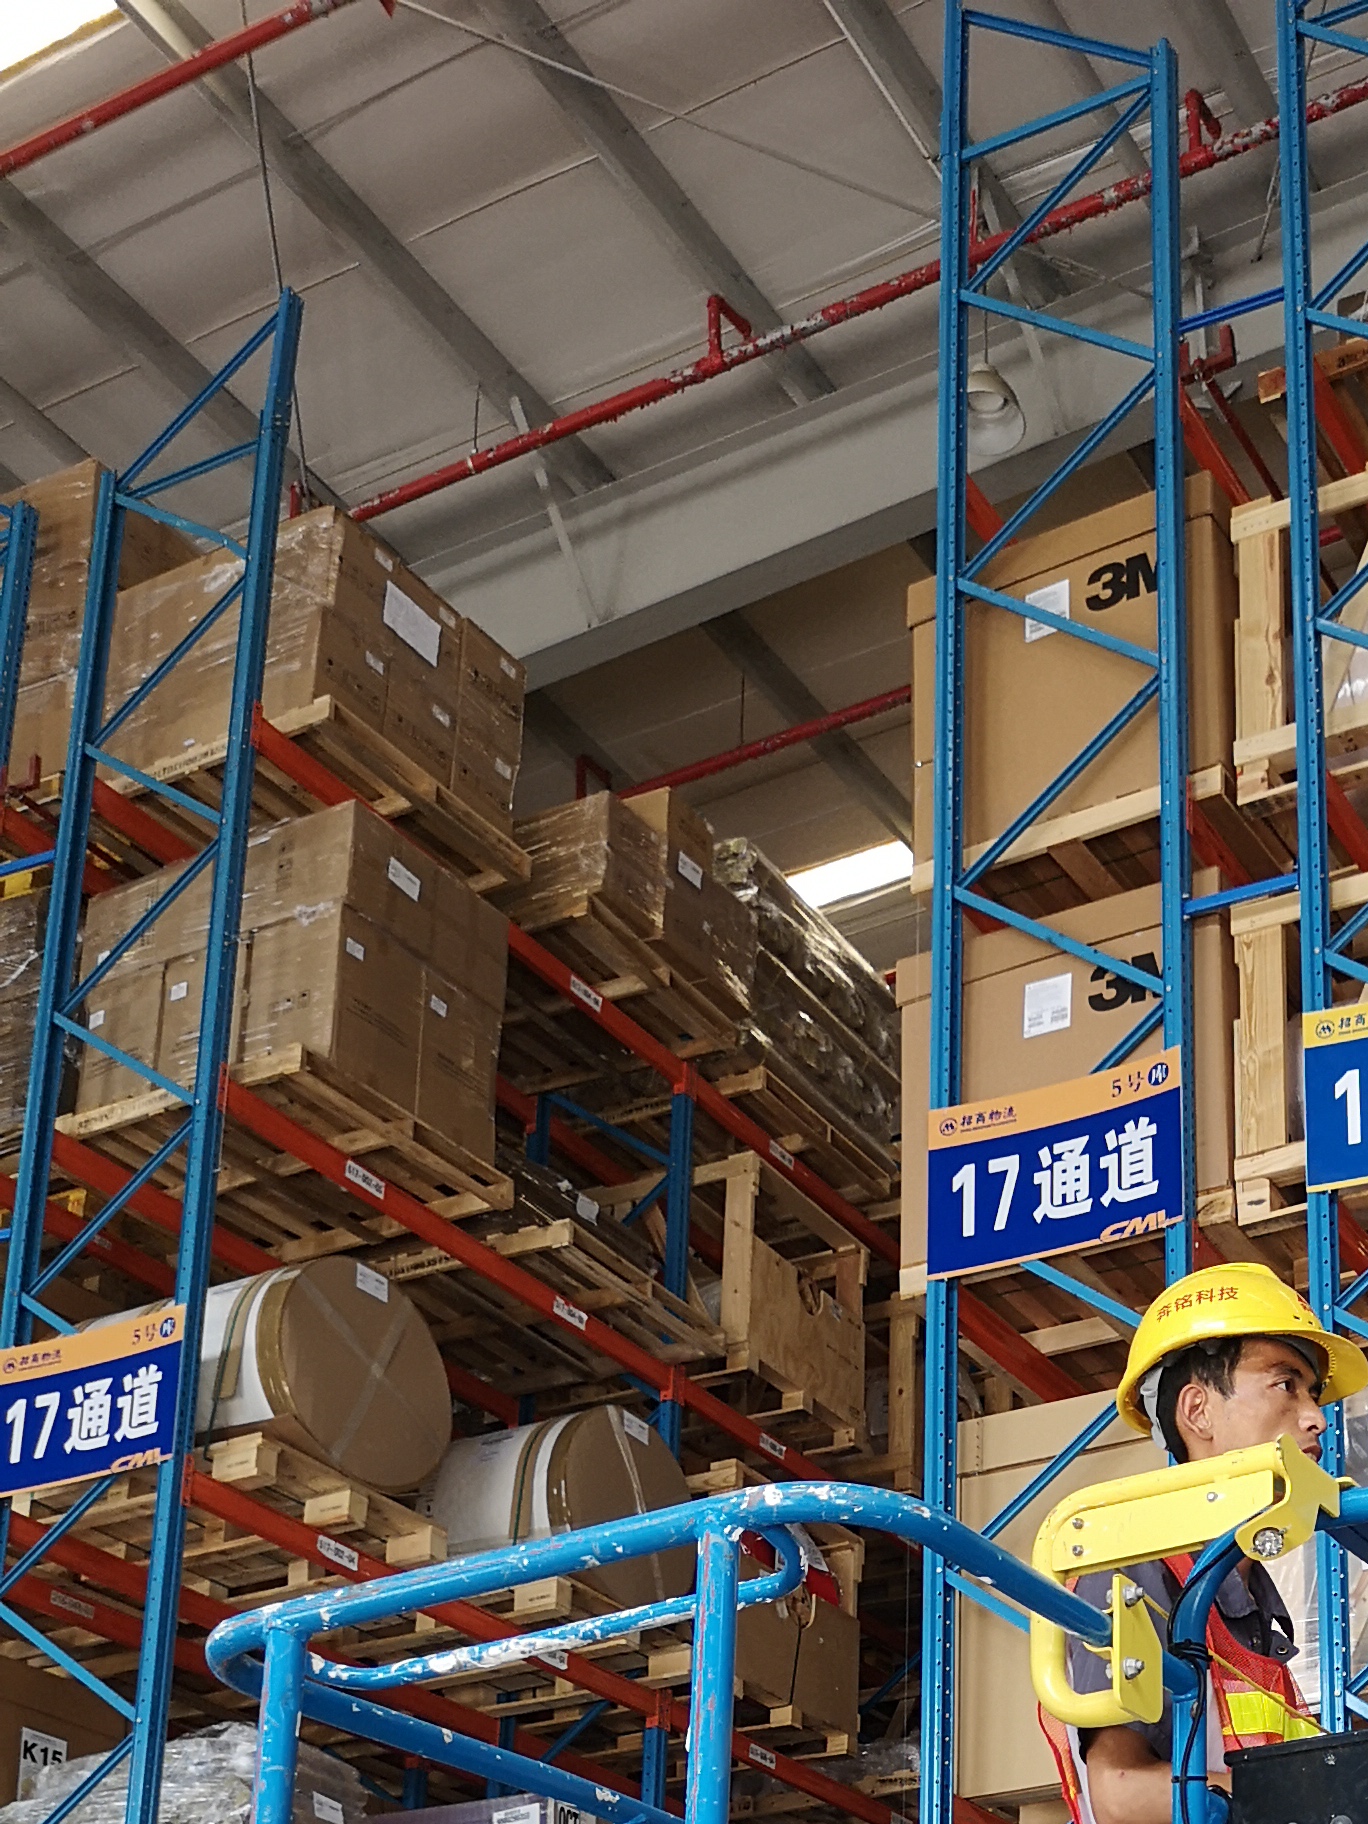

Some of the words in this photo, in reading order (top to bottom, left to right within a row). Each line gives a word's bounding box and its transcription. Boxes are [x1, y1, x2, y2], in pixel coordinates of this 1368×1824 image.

[1085, 553, 1157, 612] 3M
[960, 1105, 1017, 1127] 招商物流
[952, 1116, 1160, 1238] 17通道
[6, 1363, 163, 1464] 17通道
